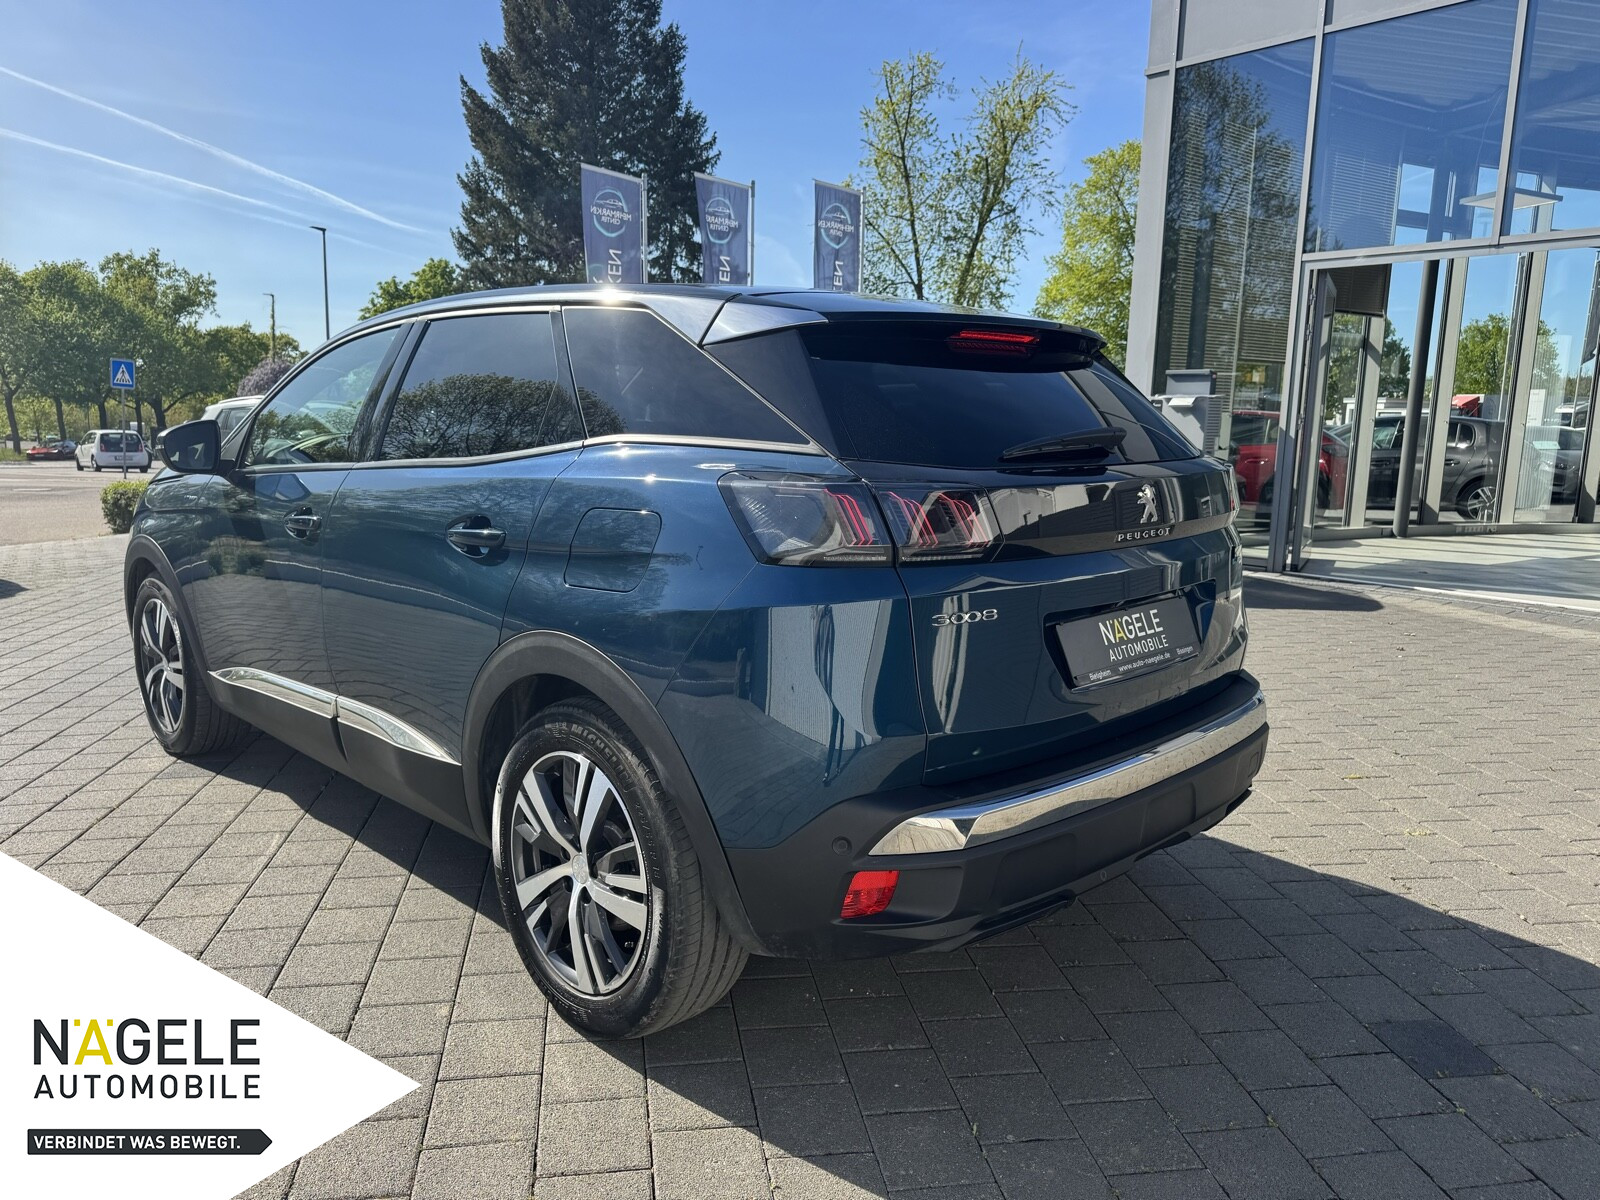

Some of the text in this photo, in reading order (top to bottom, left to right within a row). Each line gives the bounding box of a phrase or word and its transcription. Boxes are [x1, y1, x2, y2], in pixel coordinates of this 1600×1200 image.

[1117, 527, 1171, 542] PEUGEOT
[931, 608, 998, 627] 3008
[1098, 609, 1164, 646] NÄGELE
[1109, 634, 1169, 662] AUTOMOBILE
[571, 723, 635, 791] MICHELIN
